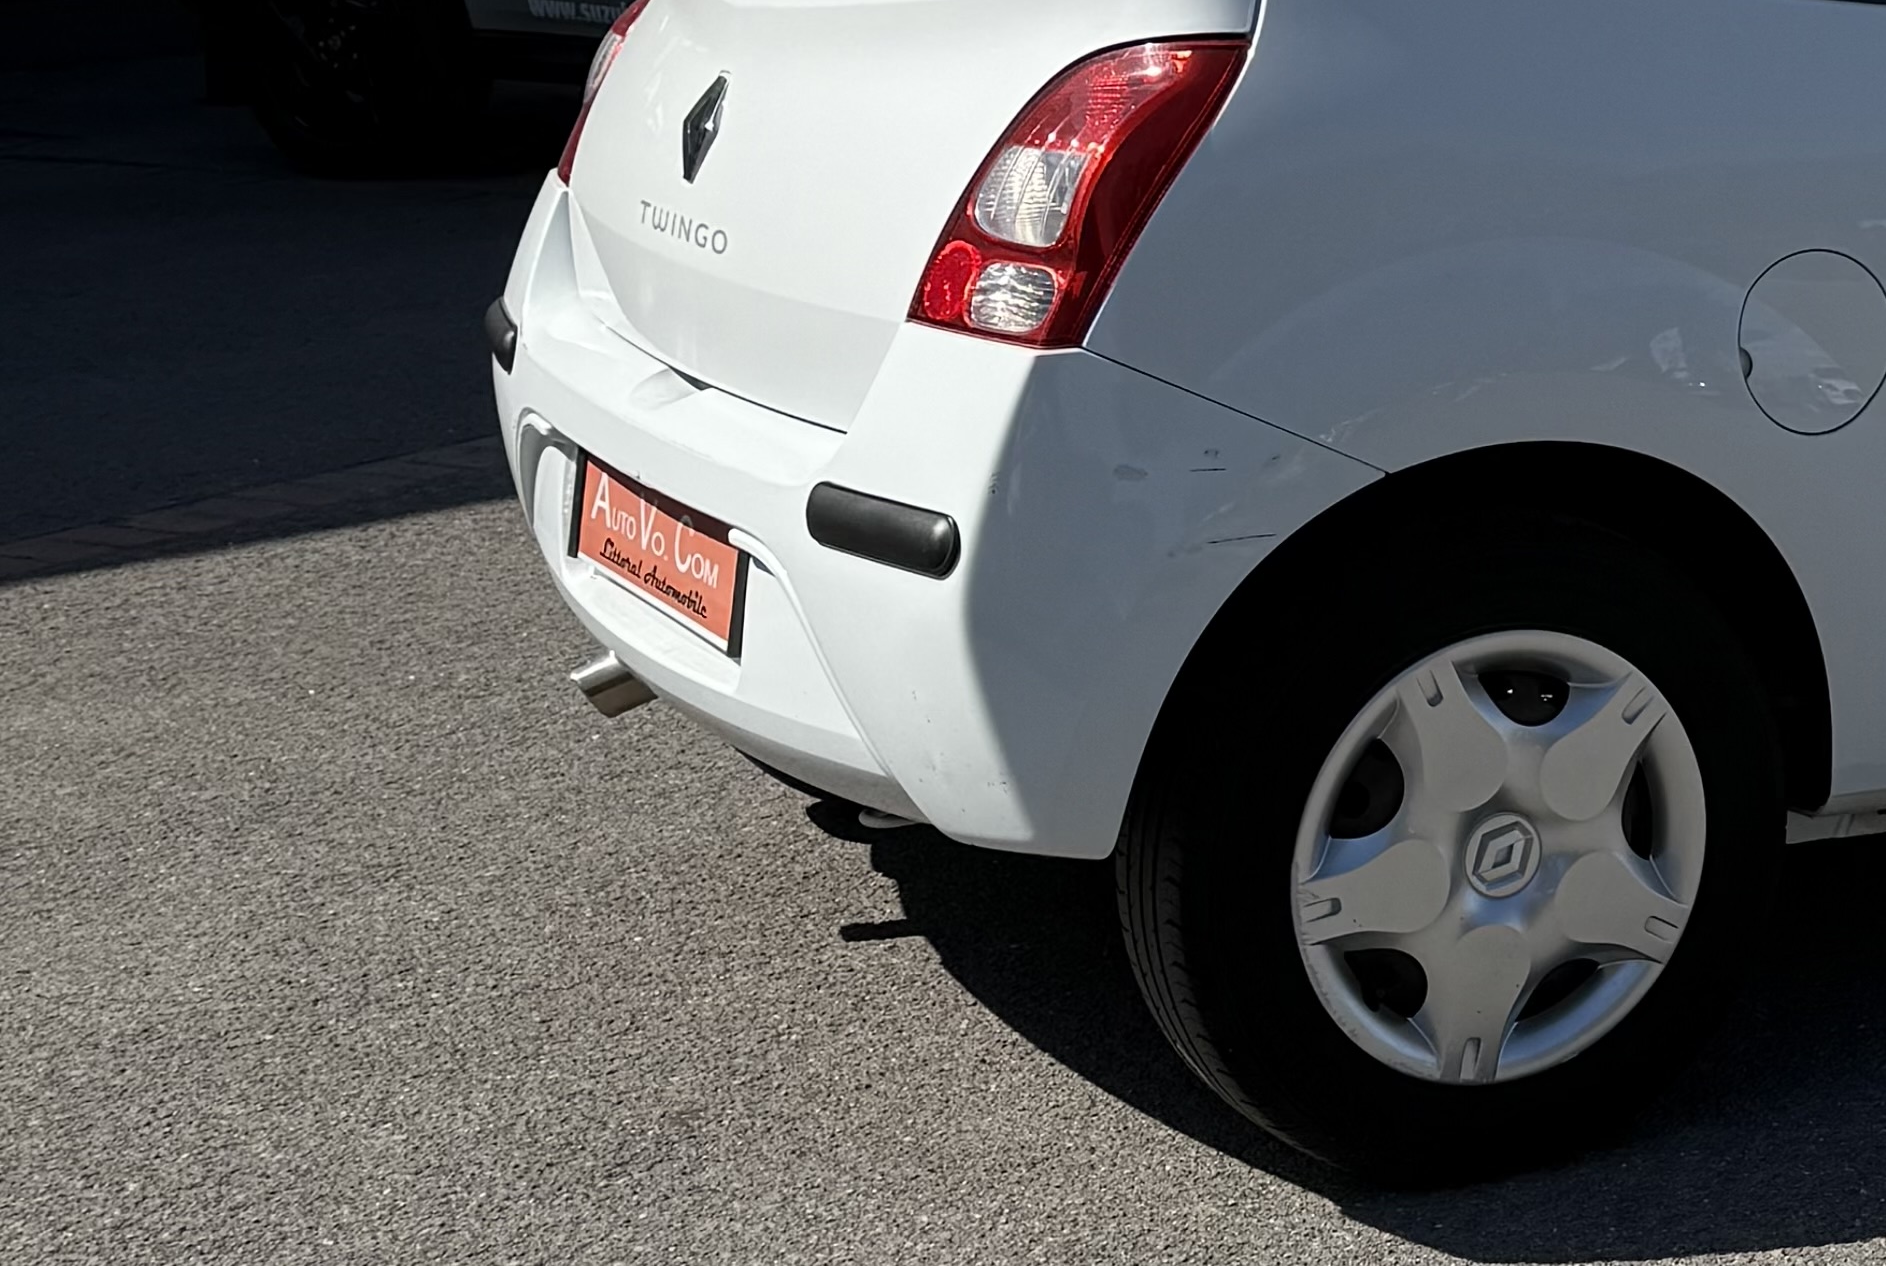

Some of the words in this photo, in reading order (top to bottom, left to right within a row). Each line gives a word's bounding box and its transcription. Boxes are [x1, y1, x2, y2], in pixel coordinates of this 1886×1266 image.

[640, 199, 729, 255] TWINGO
[599, 537, 643, 580] Littoral
[643, 565, 708, 619] Automobile
